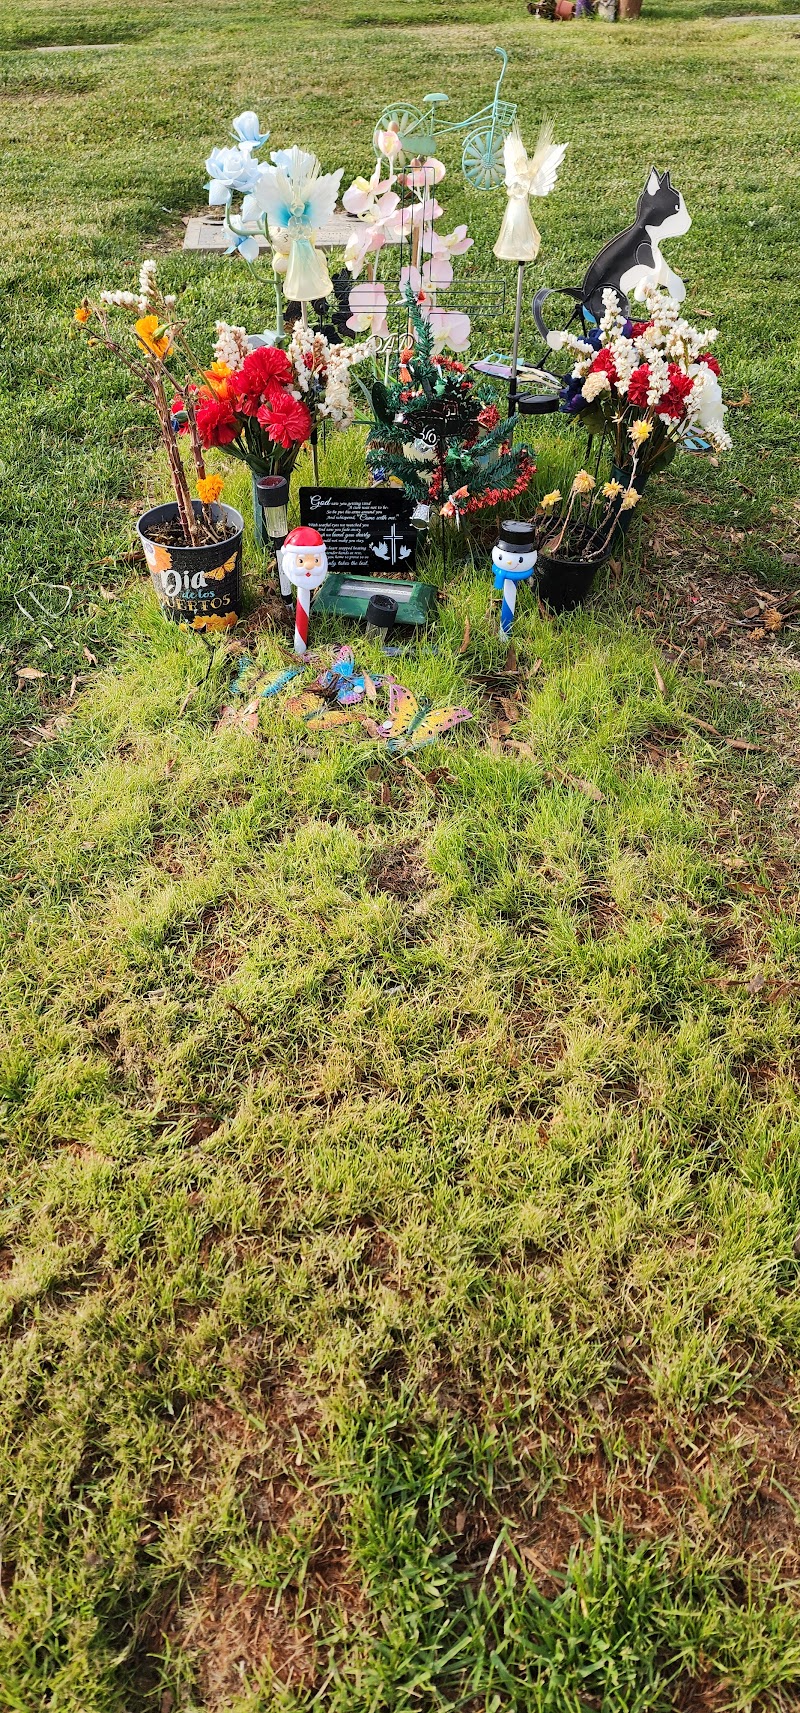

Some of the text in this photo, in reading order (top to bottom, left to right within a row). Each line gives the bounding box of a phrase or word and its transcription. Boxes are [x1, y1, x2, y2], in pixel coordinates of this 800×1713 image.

[310, 495, 332, 510] God
[182, 589, 215, 599] de los
